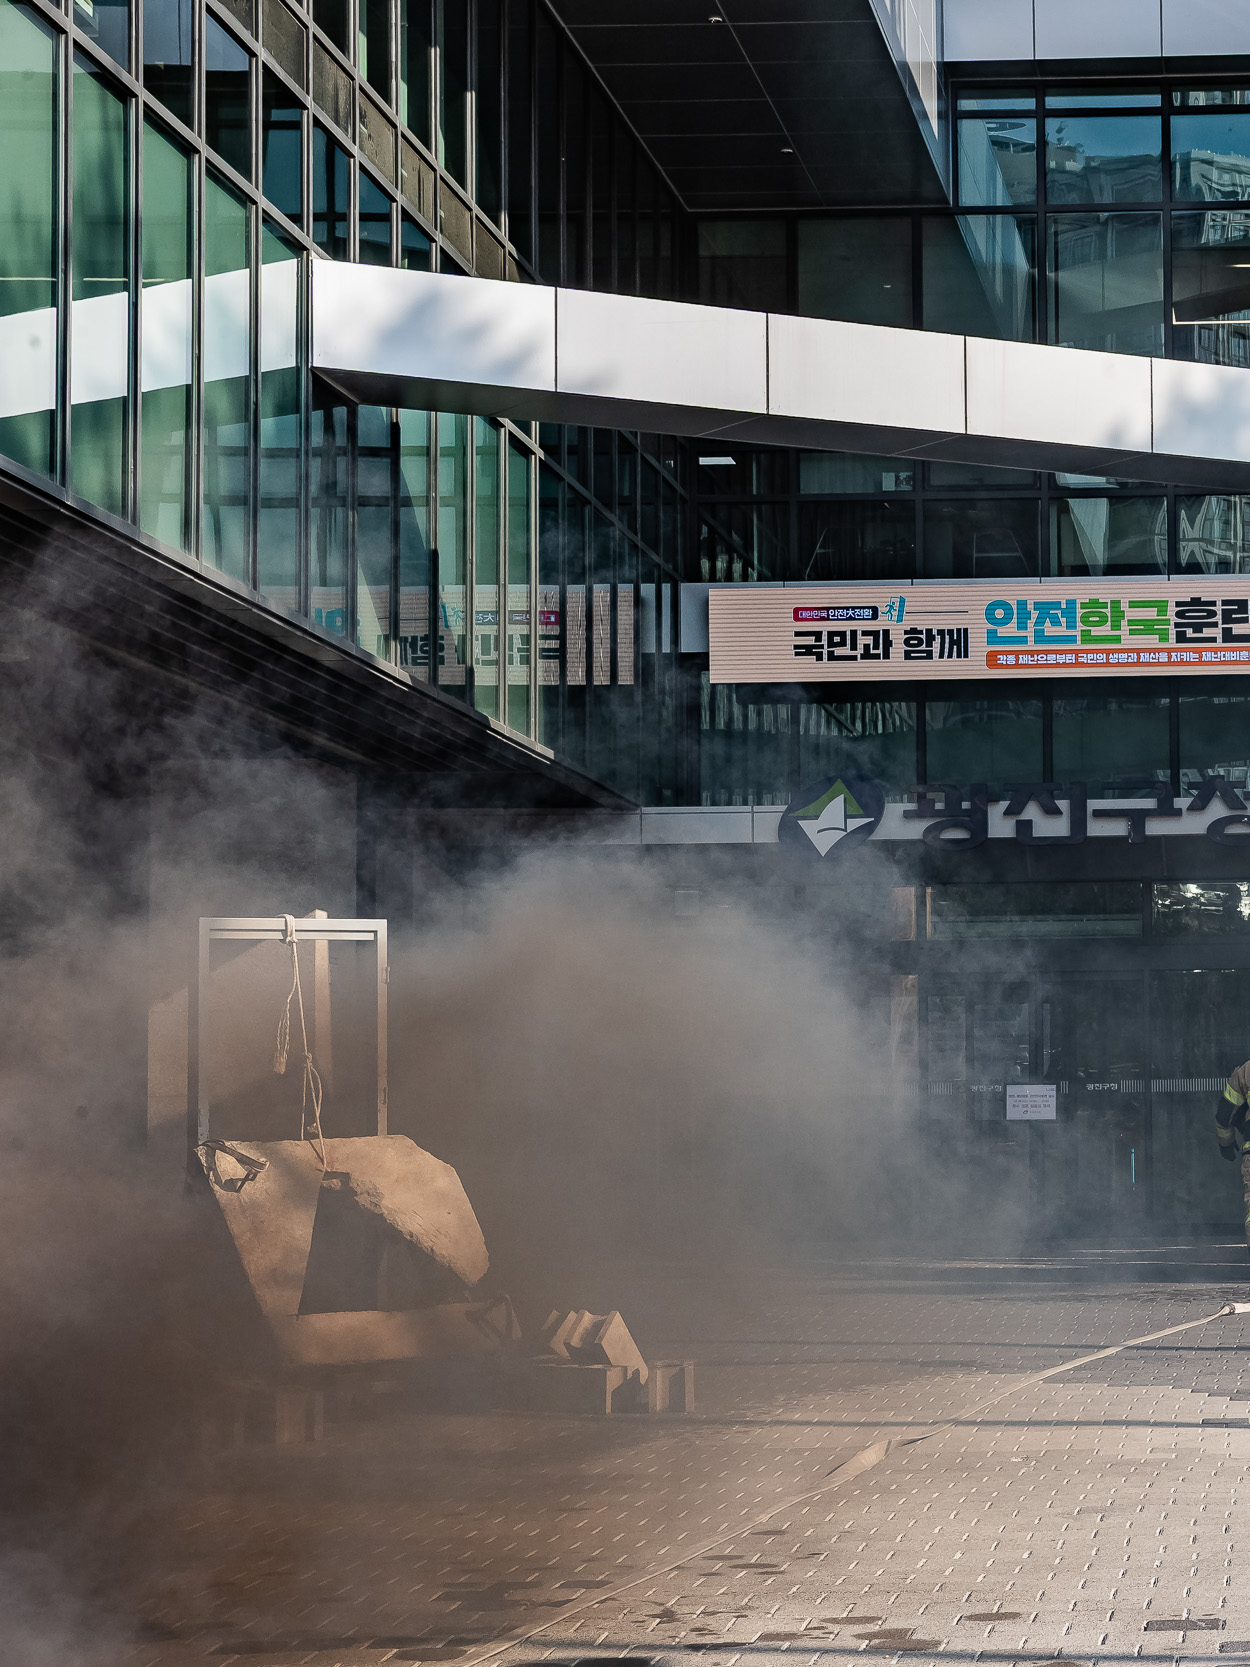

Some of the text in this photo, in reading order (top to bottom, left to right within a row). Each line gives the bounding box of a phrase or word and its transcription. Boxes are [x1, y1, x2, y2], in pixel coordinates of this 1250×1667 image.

[798, 610, 828, 619] 대한민국
[793, 627, 970, 662] 국민과 함께
[996, 654, 1016, 665] 각종
[1018, 653, 1076, 665] 재난으로부터
[1077, 653, 1107, 664] 국민의
[1109, 652, 1138, 663] 생명과
[1139, 652, 1169, 663] 재산을
[1171, 651, 1200, 663] 지키는
[1085, 1083, 1118, 1091] 광진구청
